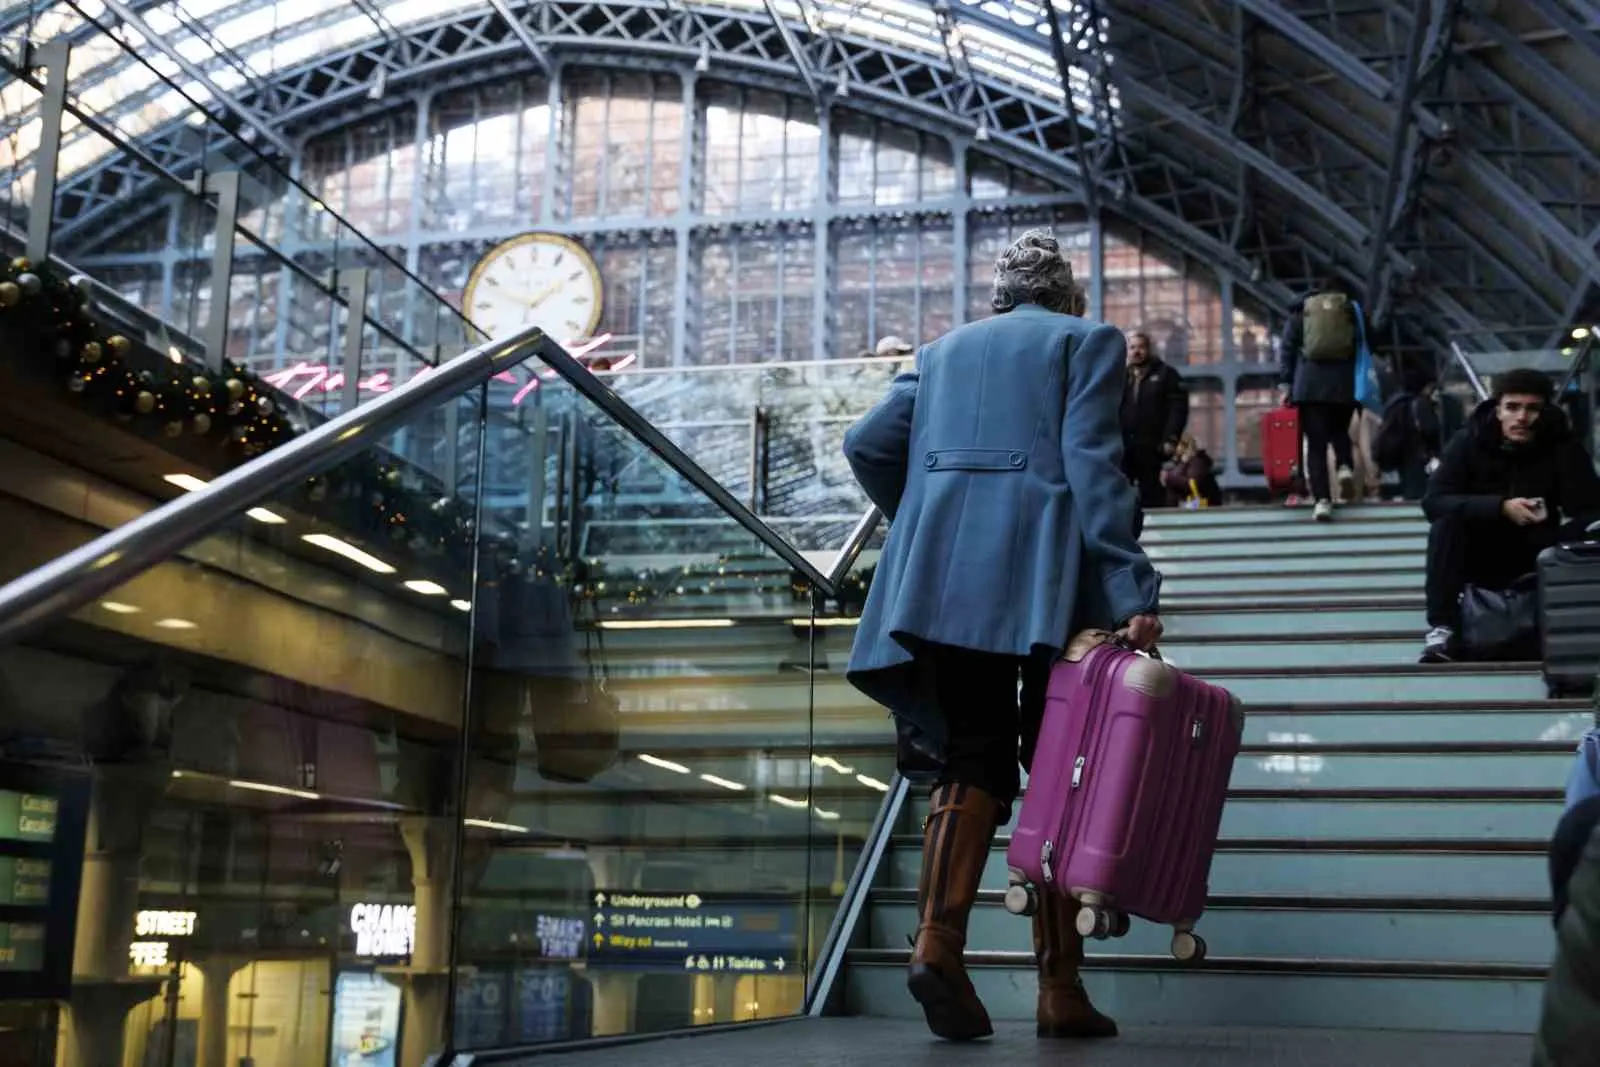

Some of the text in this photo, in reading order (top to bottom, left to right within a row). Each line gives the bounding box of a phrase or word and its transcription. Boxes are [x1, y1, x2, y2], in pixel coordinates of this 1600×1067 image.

[610, 894, 685, 910] Underground
[135, 910, 197, 935] STREET
[351, 903, 416, 932] CHANG
[627, 914, 672, 928] Pancras
[674, 914, 702, 928] Hotel
[727, 956, 767, 970] Toilets
